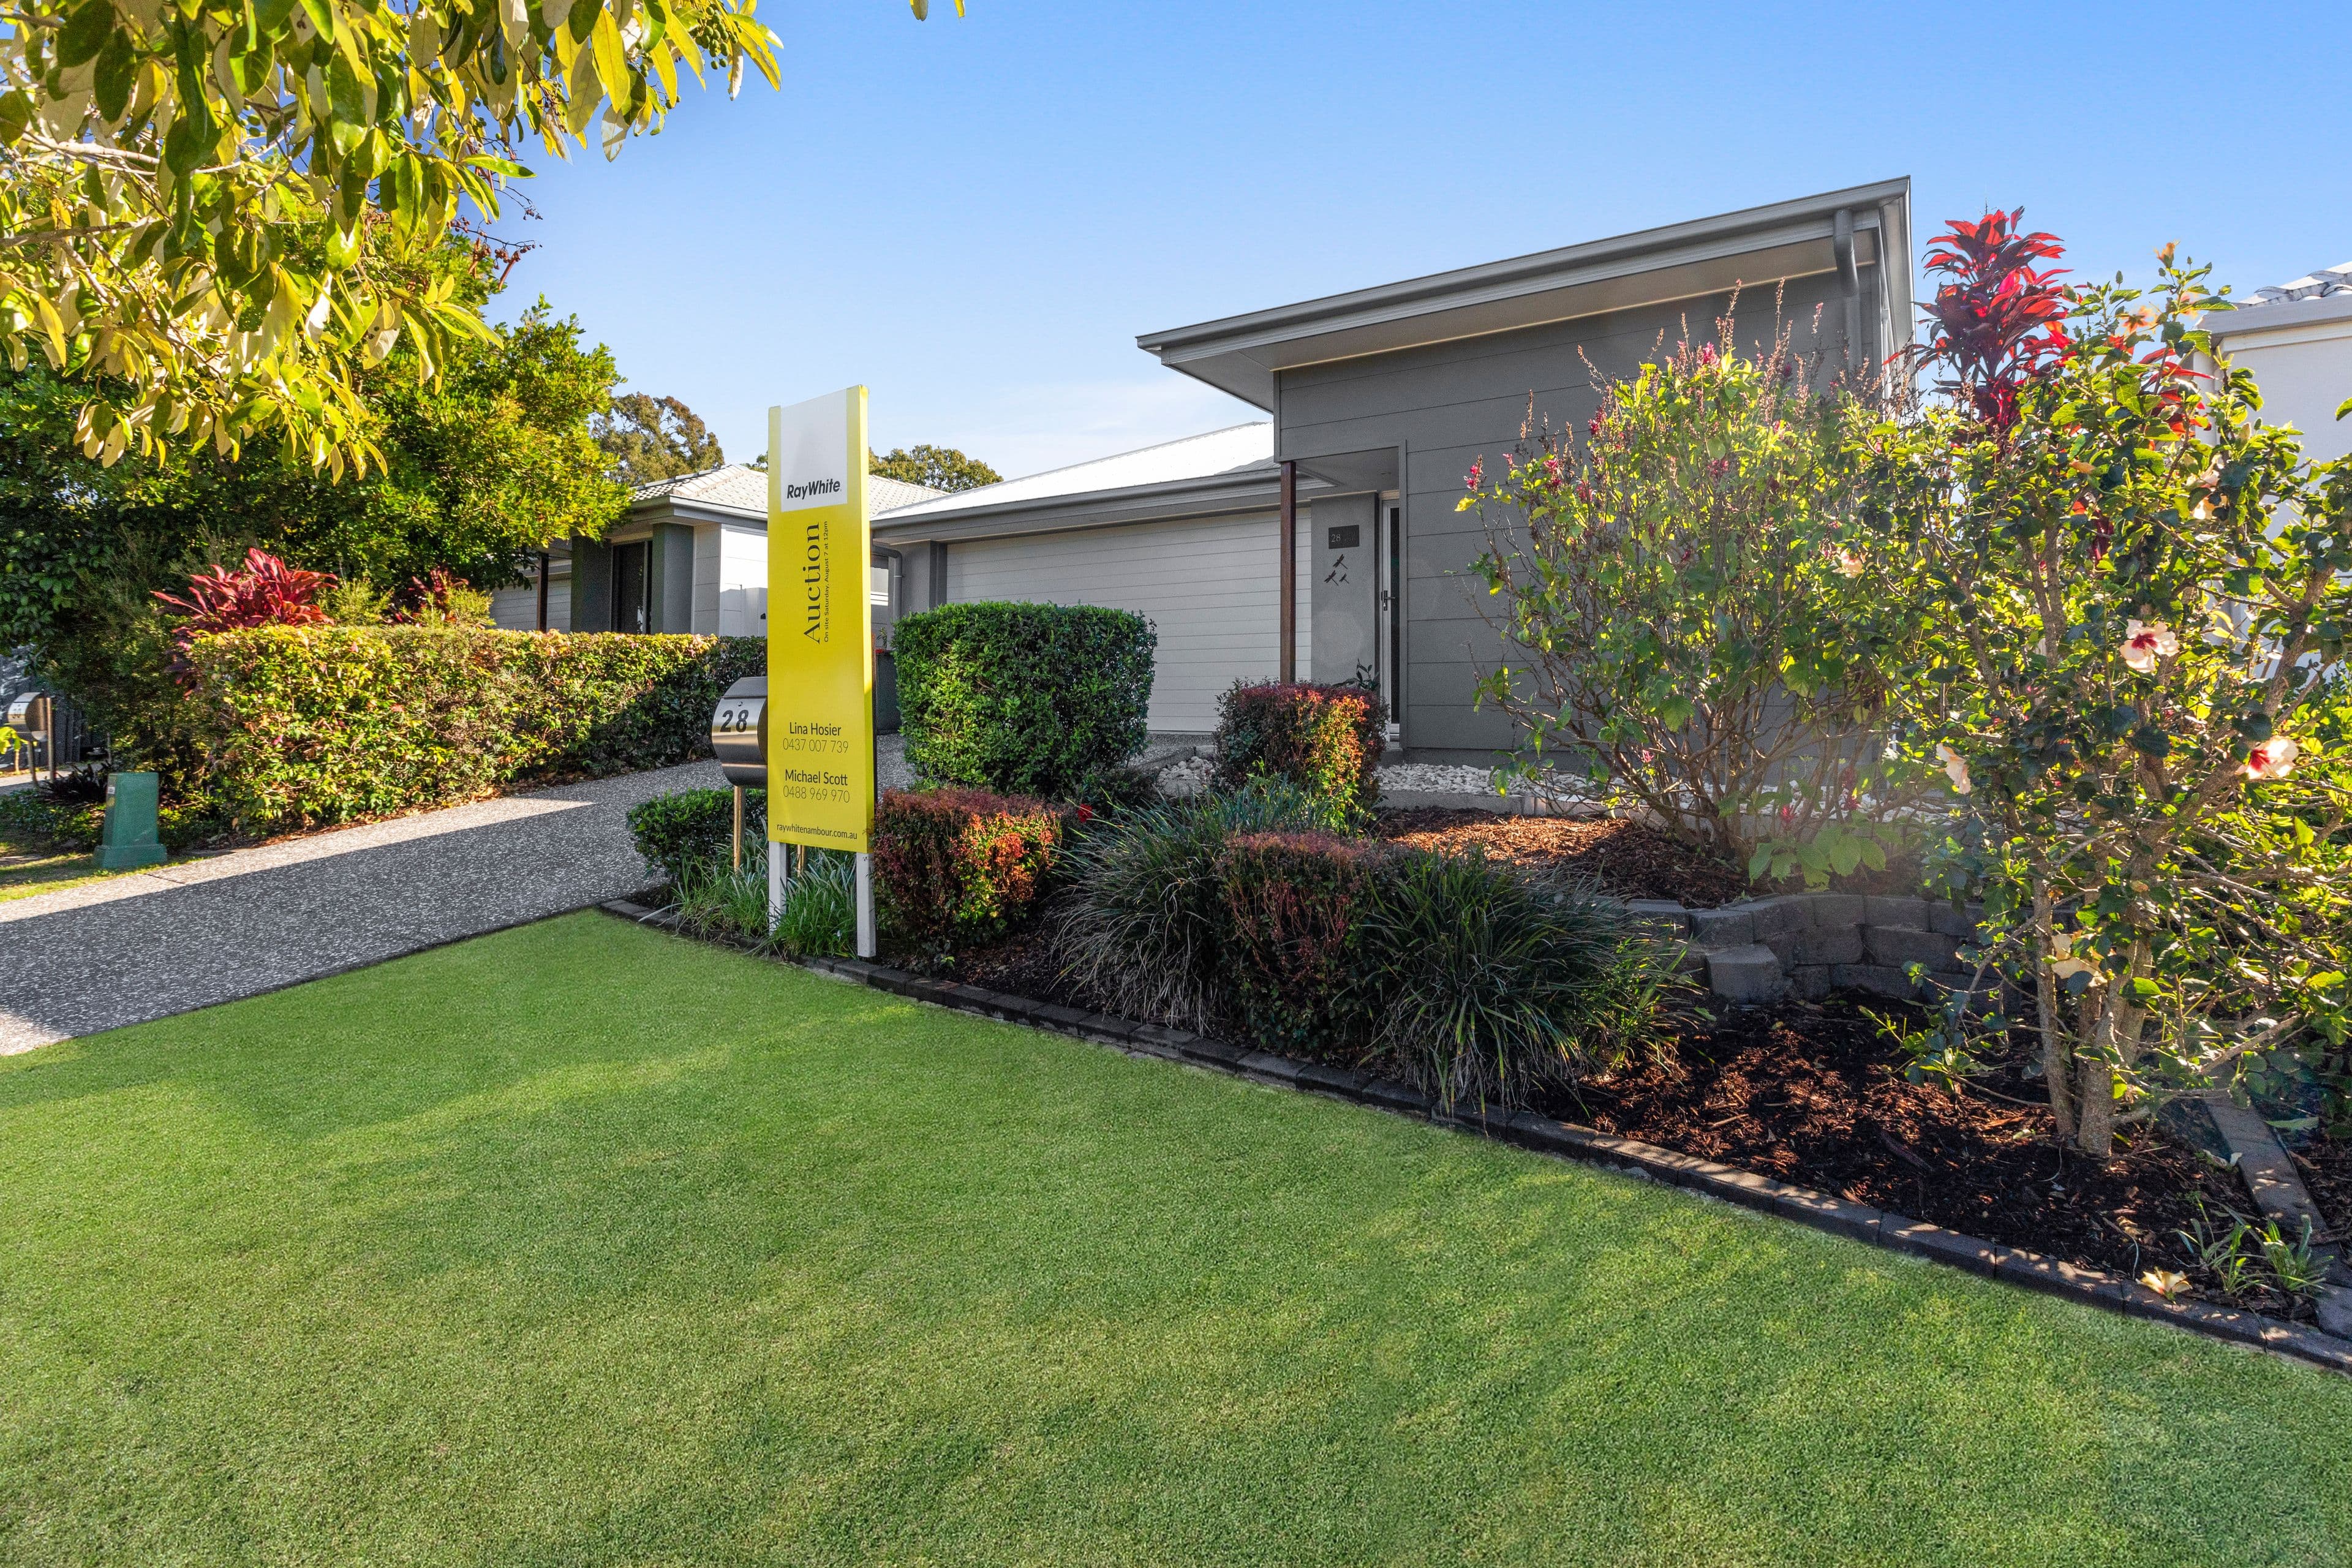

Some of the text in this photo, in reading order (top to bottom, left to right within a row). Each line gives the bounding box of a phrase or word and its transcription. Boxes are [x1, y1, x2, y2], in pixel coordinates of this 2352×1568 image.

[787, 478, 840, 500] RayWhite
[1331, 533, 1341, 543] 28
[802, 522, 821, 644] Auction
[824, 631, 829, 643] On
[720, 709, 749, 733] 28
[789, 722, 842, 736] Lina Hosier
[783, 738, 848, 753] 0437 007 739
[785, 769, 848, 786] Michael Scott
[783, 785, 850, 803] 0488 969 970
[776, 823, 858, 840] raywhitenambour.com.au
